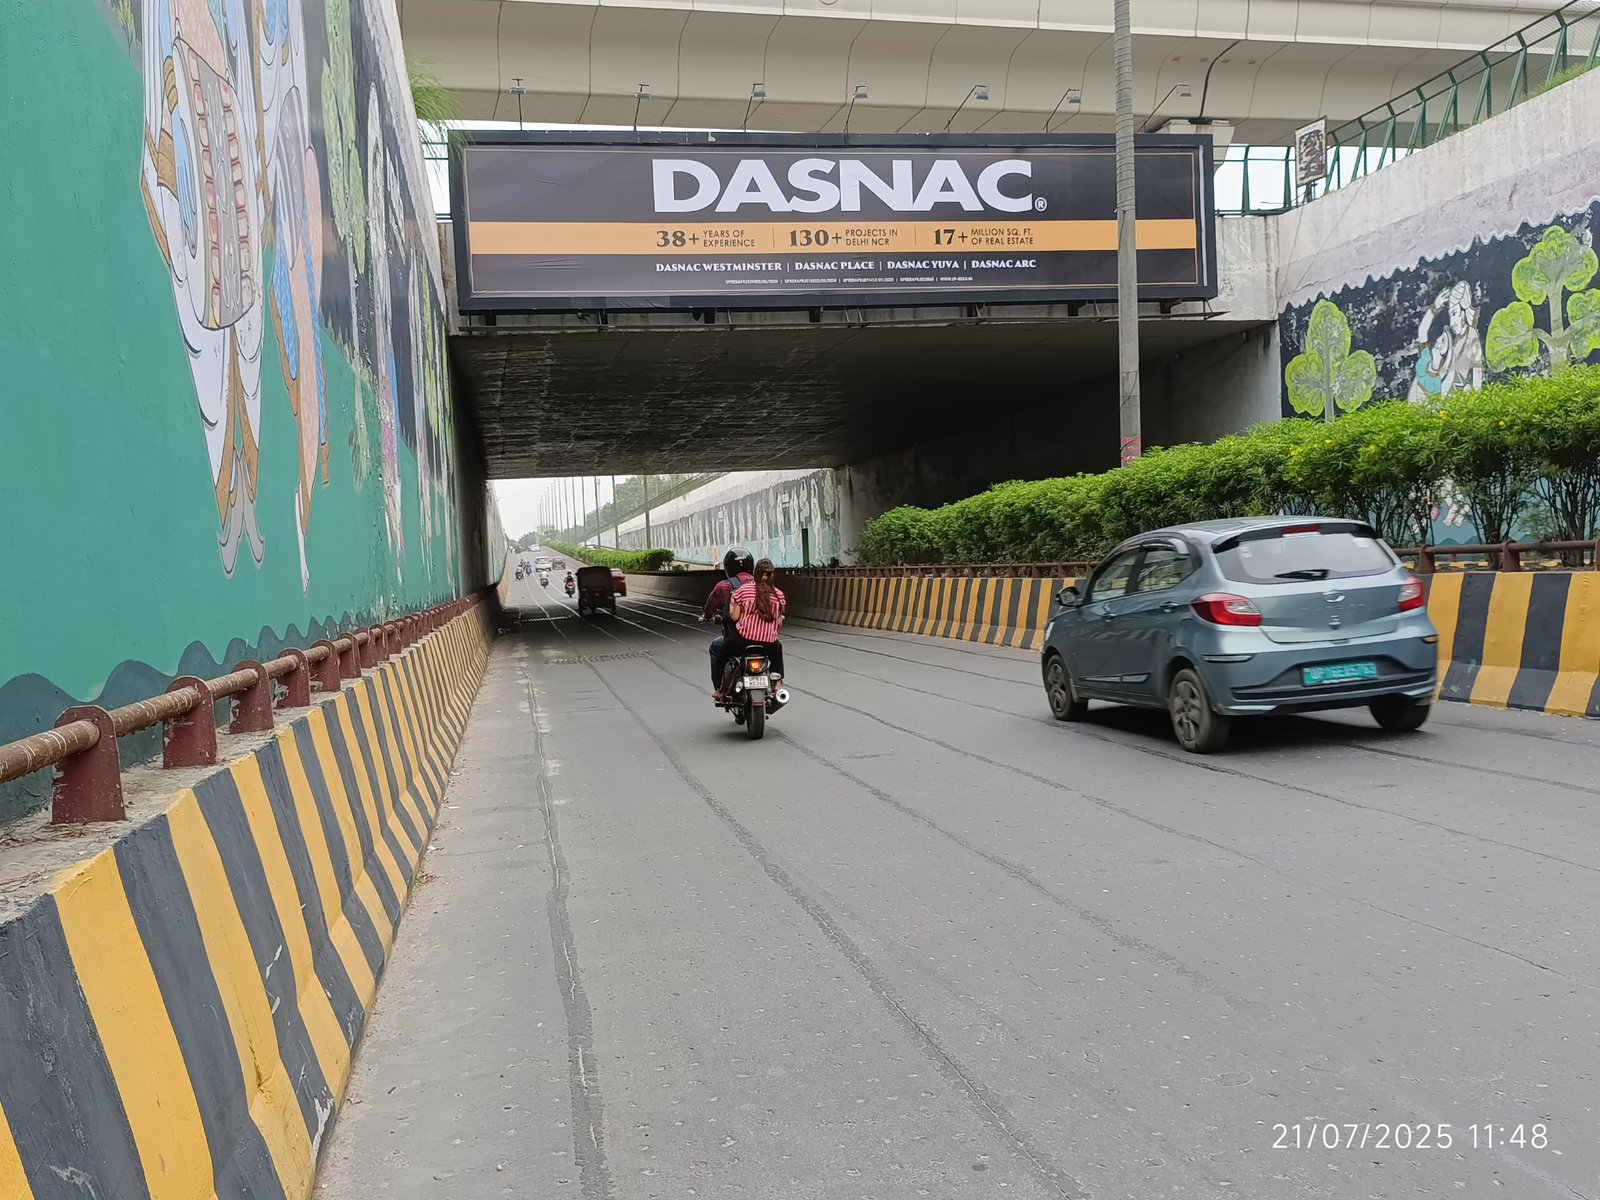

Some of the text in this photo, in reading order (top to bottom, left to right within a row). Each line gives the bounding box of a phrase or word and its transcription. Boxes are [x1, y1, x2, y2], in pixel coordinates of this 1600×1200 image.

[652, 158, 1033, 213] DASNAC
[703, 229, 745, 238] YEARS OF
[845, 228, 898, 237] PROJECTS IN
[971, 228, 1034, 236] MILLION SQ. FT.
[656, 230, 700, 248] 38+
[789, 229, 842, 247] 130+
[933, 228, 968, 246] 17+
[971, 237, 1034, 245] OF REAL ESTATE
[703, 239, 756, 247] EXPERIENCE
[846, 238, 890, 246] DELHI NCR
[655, 259, 1037, 272] DASNAC WESTMINSTER DASNAC PLACE DASNAC YUVA DASNAC ARC
